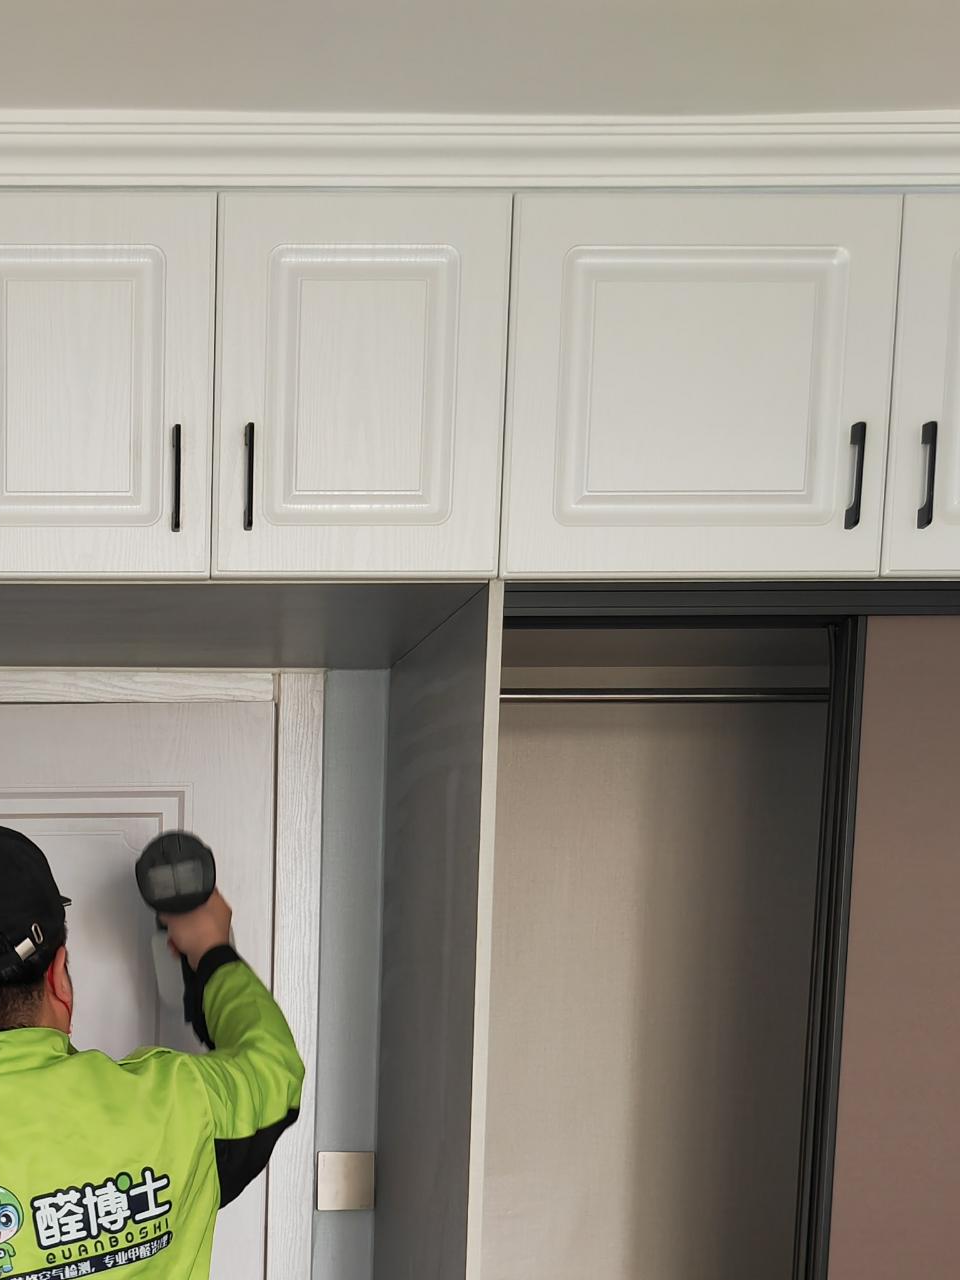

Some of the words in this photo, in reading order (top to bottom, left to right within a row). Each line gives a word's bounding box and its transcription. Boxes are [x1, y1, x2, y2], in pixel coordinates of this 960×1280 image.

[30, 1168, 171, 1248] 醛博士
[45, 1217, 169, 1264] QUANBOSHI
